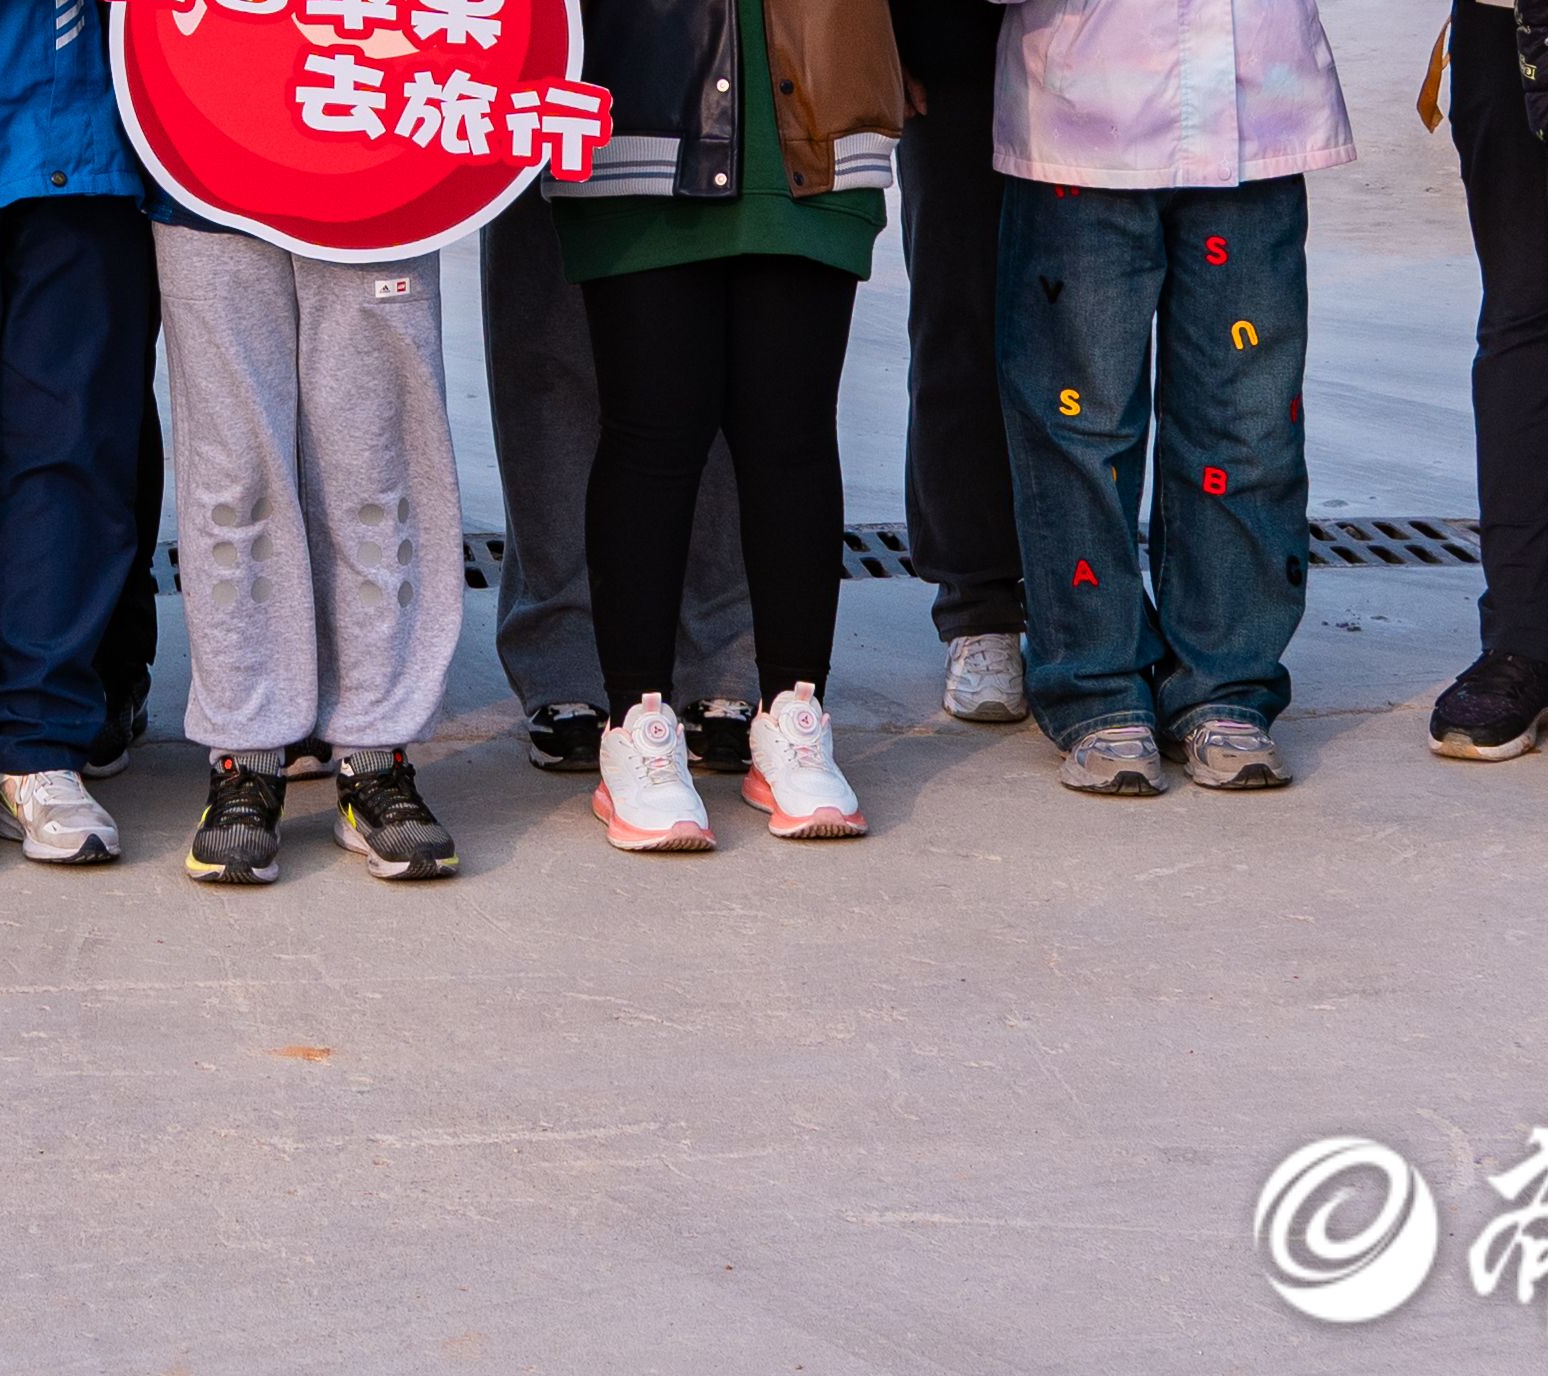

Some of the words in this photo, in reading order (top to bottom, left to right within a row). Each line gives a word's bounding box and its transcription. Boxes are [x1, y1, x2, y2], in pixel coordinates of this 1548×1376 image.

[295, 53, 601, 171] 去旅行
[1059, 389, 1081, 416] S
[1203, 466, 1227, 495] B
[1072, 560, 1099, 587] A
